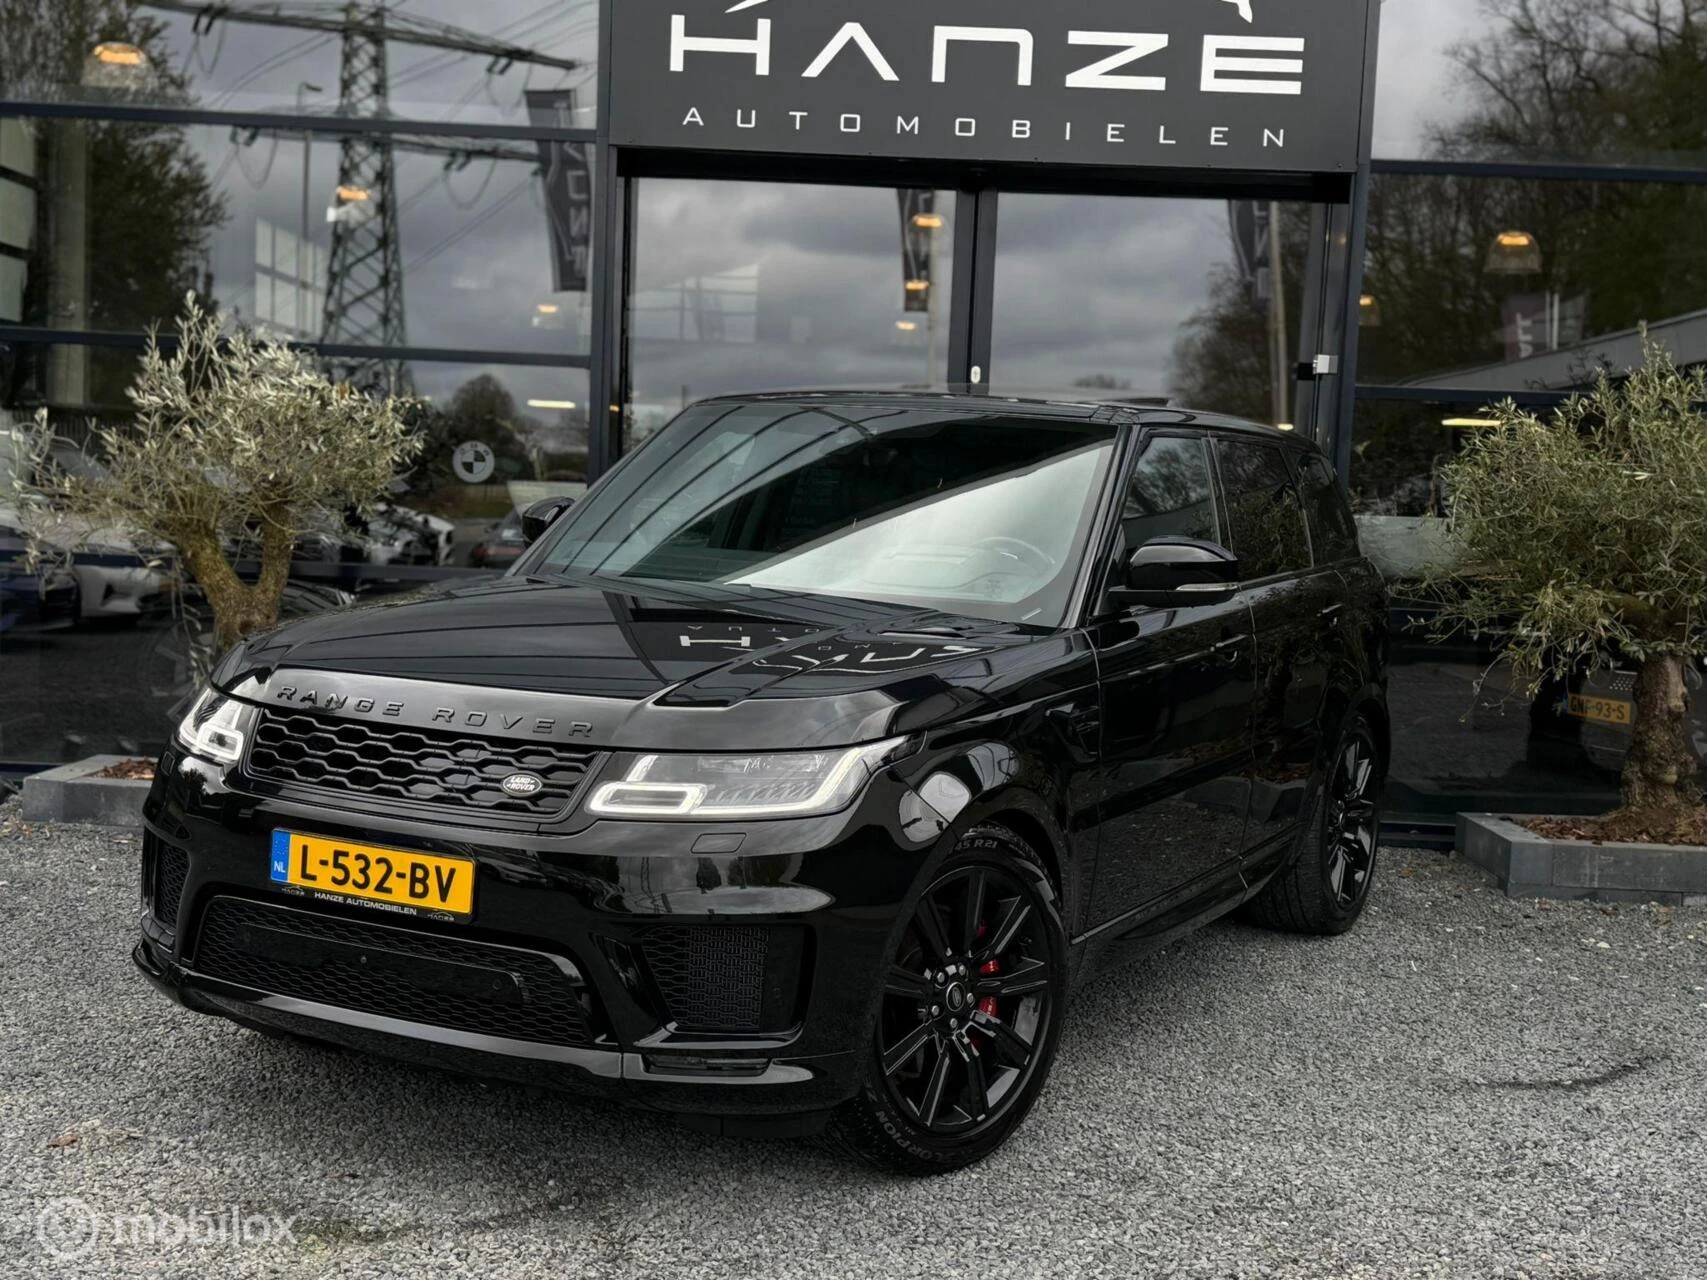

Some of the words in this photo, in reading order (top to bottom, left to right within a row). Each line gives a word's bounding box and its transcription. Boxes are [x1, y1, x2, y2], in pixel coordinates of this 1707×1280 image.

[669, 14, 1305, 95] HANZE
[683, 107, 1284, 148] AUTOMOBIELEN
[277, 685, 404, 717] RANGE
[432, 706, 593, 737] ROVER
[273, 861, 286, 874] NL
[300, 844, 457, 903] L-532-BV
[314, 891, 345, 904] HANZE
[346, 897, 417, 916] AUTOMOBIELEN
